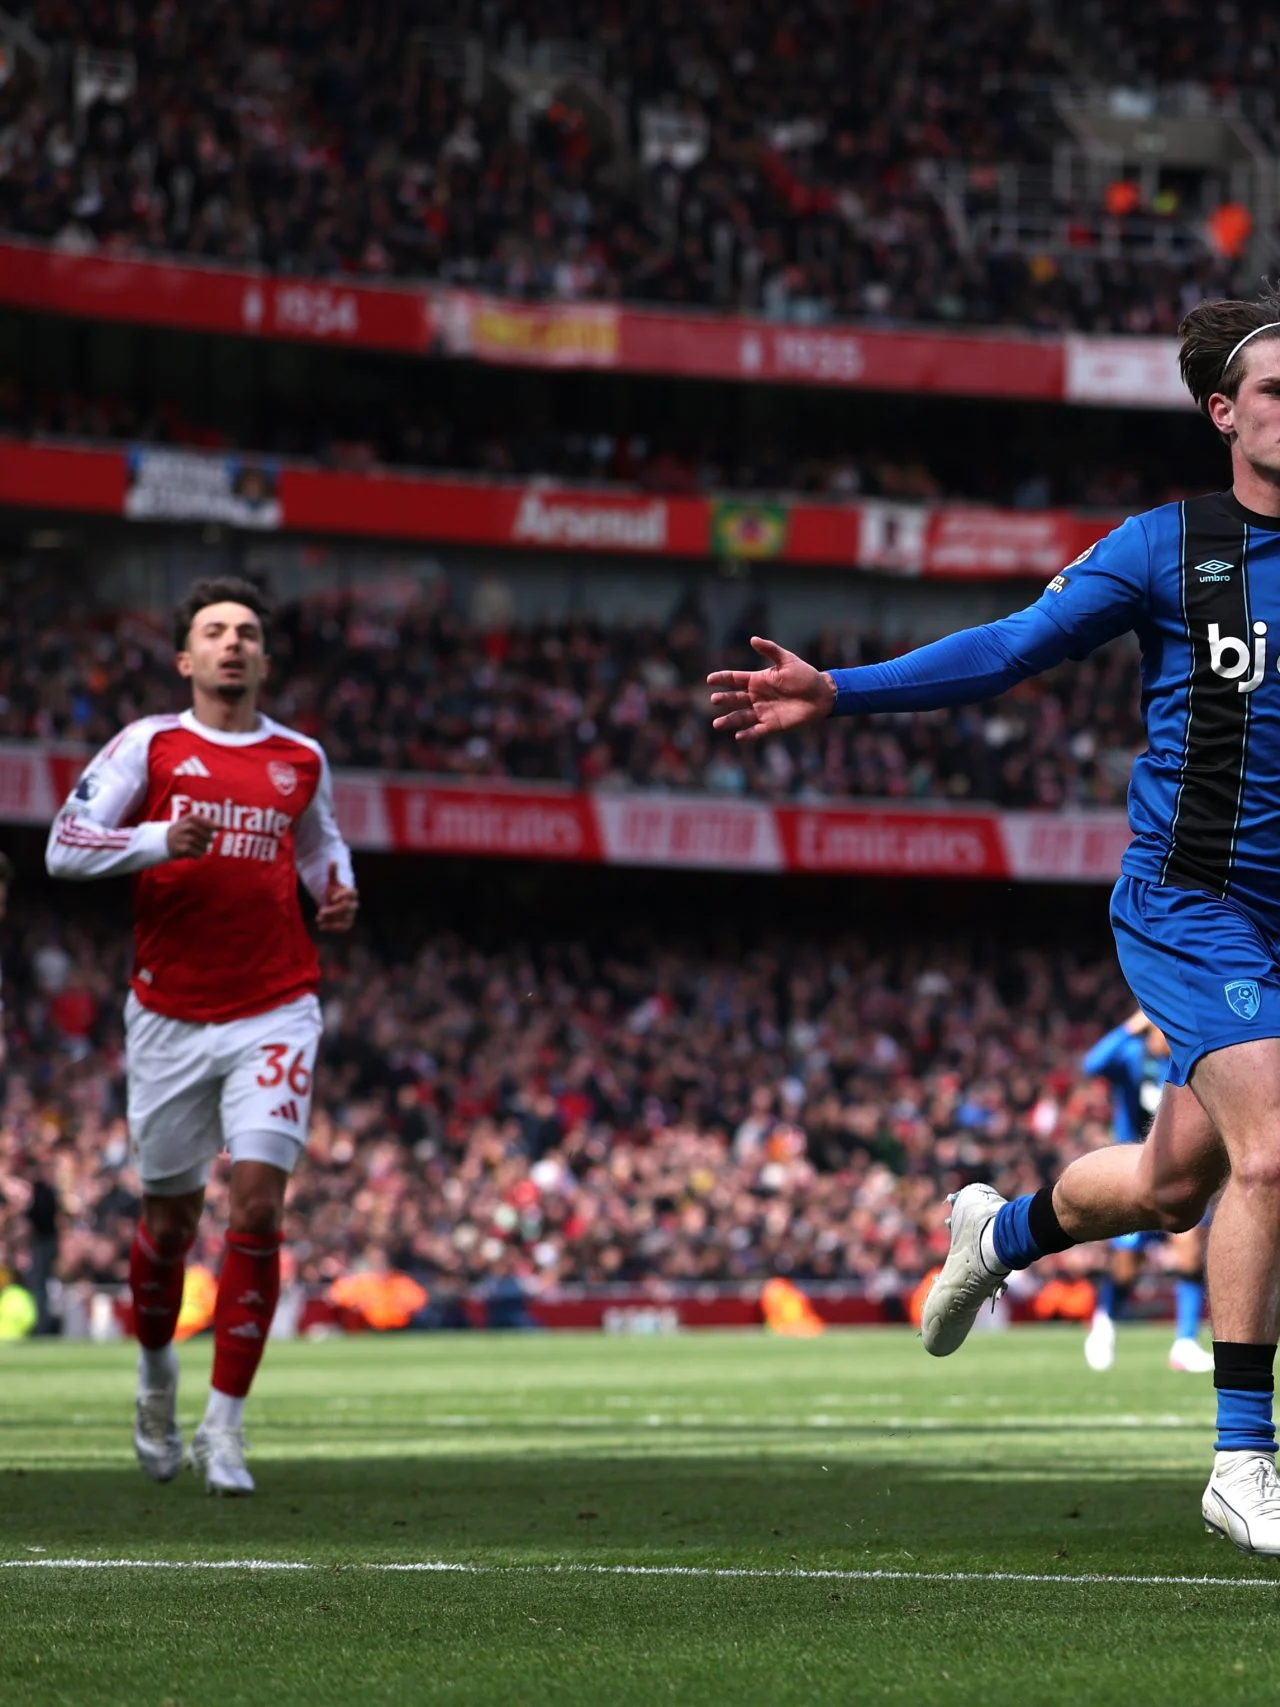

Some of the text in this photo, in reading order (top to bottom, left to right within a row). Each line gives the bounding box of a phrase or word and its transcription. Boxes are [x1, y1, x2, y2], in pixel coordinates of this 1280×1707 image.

[512, 486, 669, 551] Arsenal
[1199, 574, 1231, 583] umbro
[405, 790, 585, 853] Emirates
[797, 804, 987, 872] Emirates
[256, 1043, 313, 1097] 36
